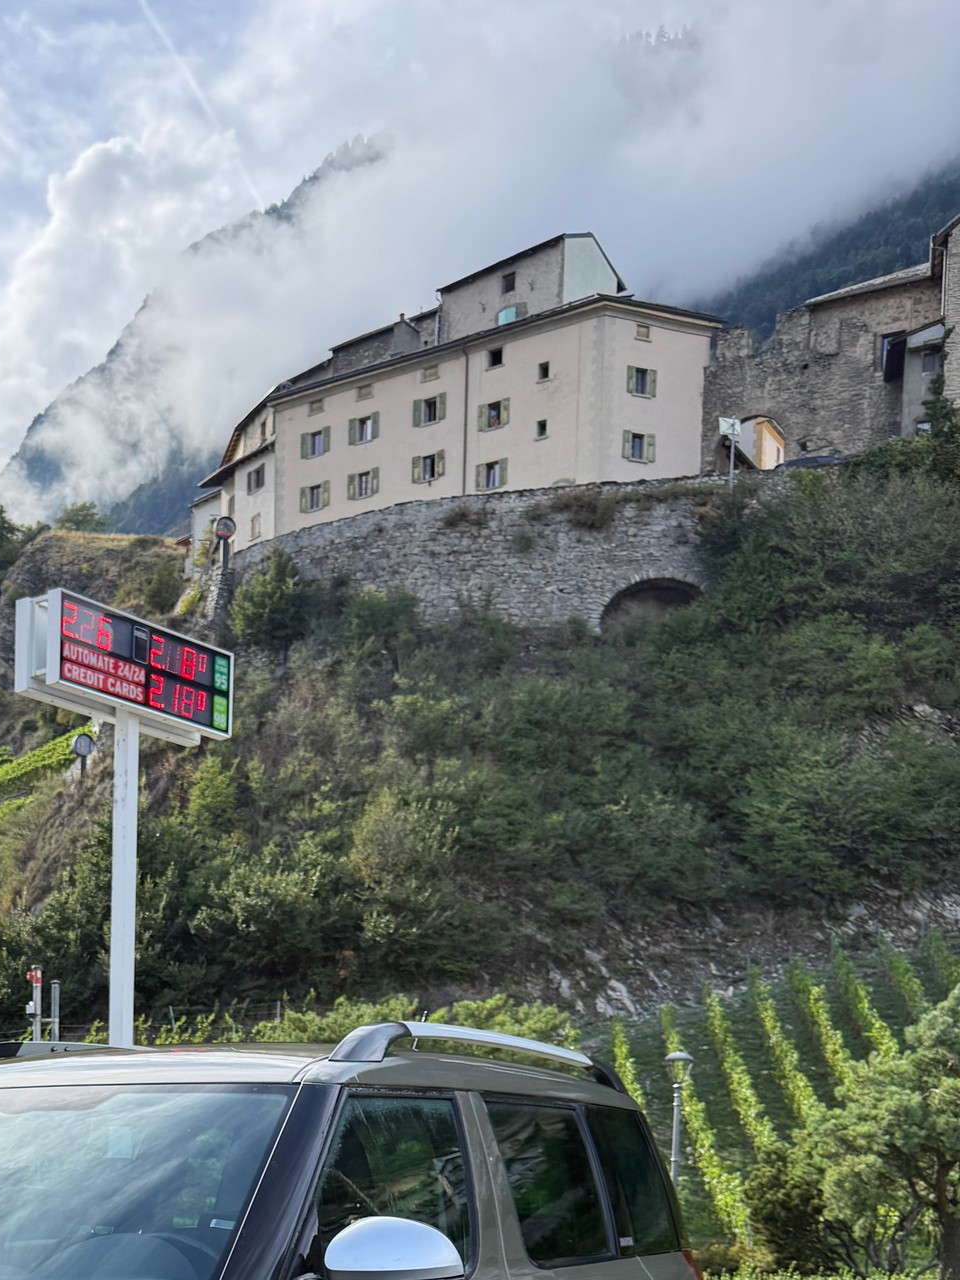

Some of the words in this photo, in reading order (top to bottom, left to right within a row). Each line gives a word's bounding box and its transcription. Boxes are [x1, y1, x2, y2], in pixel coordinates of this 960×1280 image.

[63, 643, 116, 673] AUTOMATE
[117, 662, 146, 684] 24/24
[64, 663, 105, 688] CREDIT
[107, 678, 144, 702] CARDS
[214, 673, 228, 690] 95
[213, 711, 227, 728] 98
